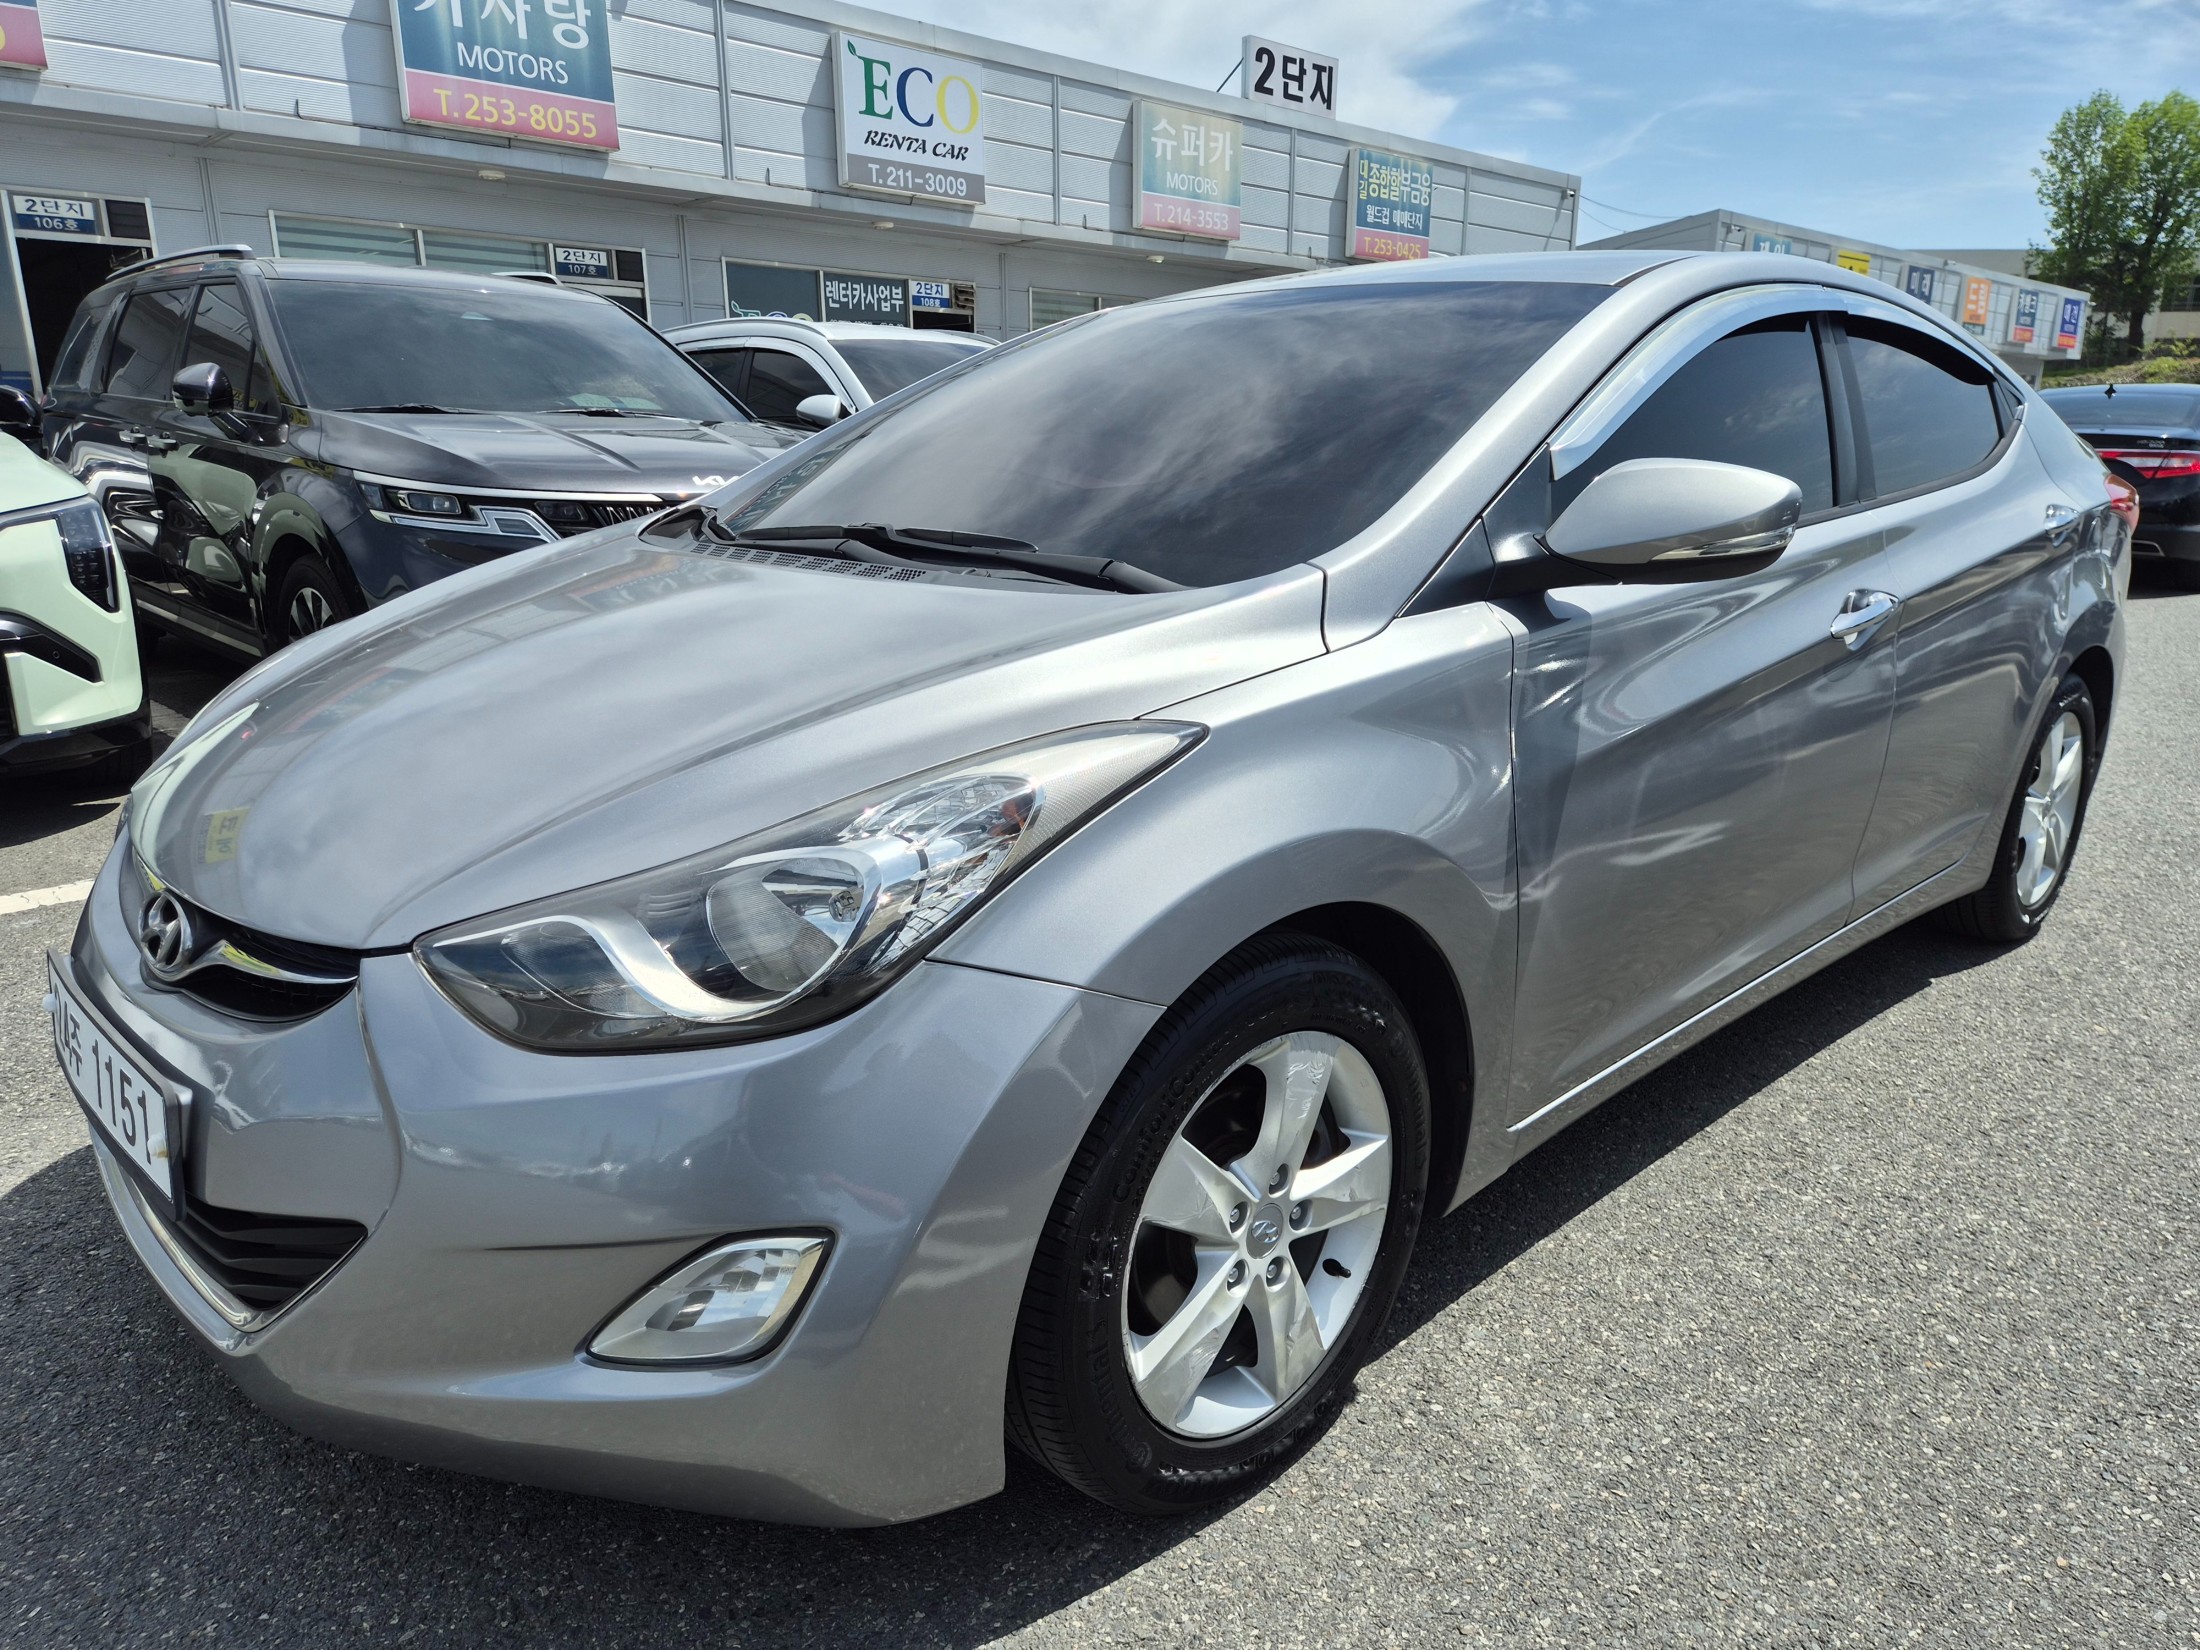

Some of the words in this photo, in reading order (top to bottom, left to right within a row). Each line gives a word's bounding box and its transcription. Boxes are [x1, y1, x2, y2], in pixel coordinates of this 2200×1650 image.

[456, 42, 570, 84] MOTORS
[1254, 46, 1334, 111] 2단지
[855, 55, 980, 135] ECO
[433, 88, 598, 139] T.253-8055
[864, 129, 928, 155] RENTA
[932, 142, 969, 161] CAR
[1150, 118, 1233, 172] 슈퍼카
[867, 163, 968, 197] T.211-3009
[1166, 171, 1218, 195] MOTORS
[24, 198, 84, 217] 2단지
[1153, 202, 1229, 231] T.214-3553
[1366, 204, 1390, 225] 월드컵
[34, 217, 80, 231] 106호
[562, 249, 601, 264] 2단지
[568, 264, 598, 275] 107호
[825, 280, 905, 313] 렌터카사업부
[915, 282, 945, 297] 2단지
[919, 297, 942, 307] 108호
[91, 1038, 152, 1164] 1151
